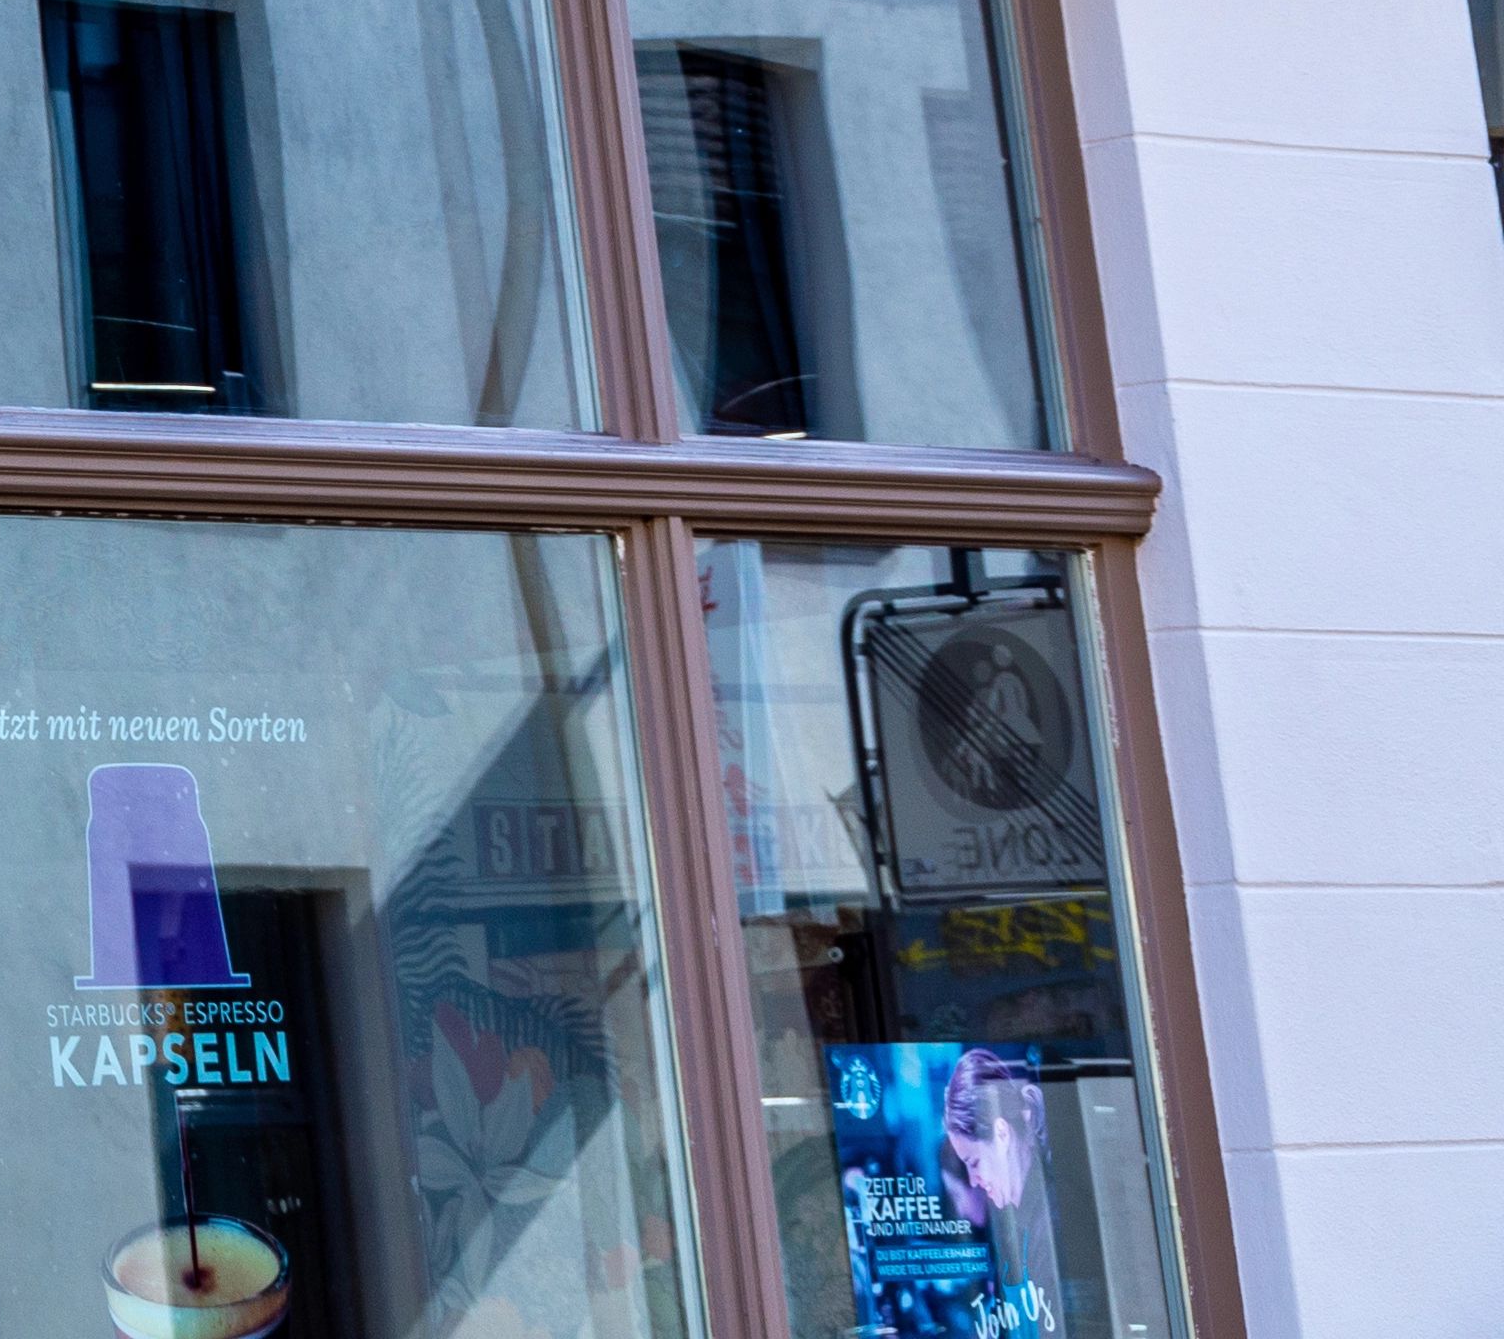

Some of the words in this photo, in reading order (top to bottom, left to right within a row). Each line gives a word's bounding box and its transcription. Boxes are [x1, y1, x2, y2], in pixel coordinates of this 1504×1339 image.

[46, 705, 101, 741] mit
[108, 713, 201, 742] neuen
[207, 706, 308, 743] Sorten
[183, 1000, 284, 1025] ESPRESSO
[49, 1031, 291, 1088] KAPSELN
[865, 1177, 894, 1196] ZEIT
[897, 1173, 926, 1196] FÜR
[868, 1196, 942, 1221] KAFFEE
[869, 1222, 894, 1237] UND
[895, 1219, 972, 1236] MITEINANDER
[971, 1293, 1020, 1339] Join
